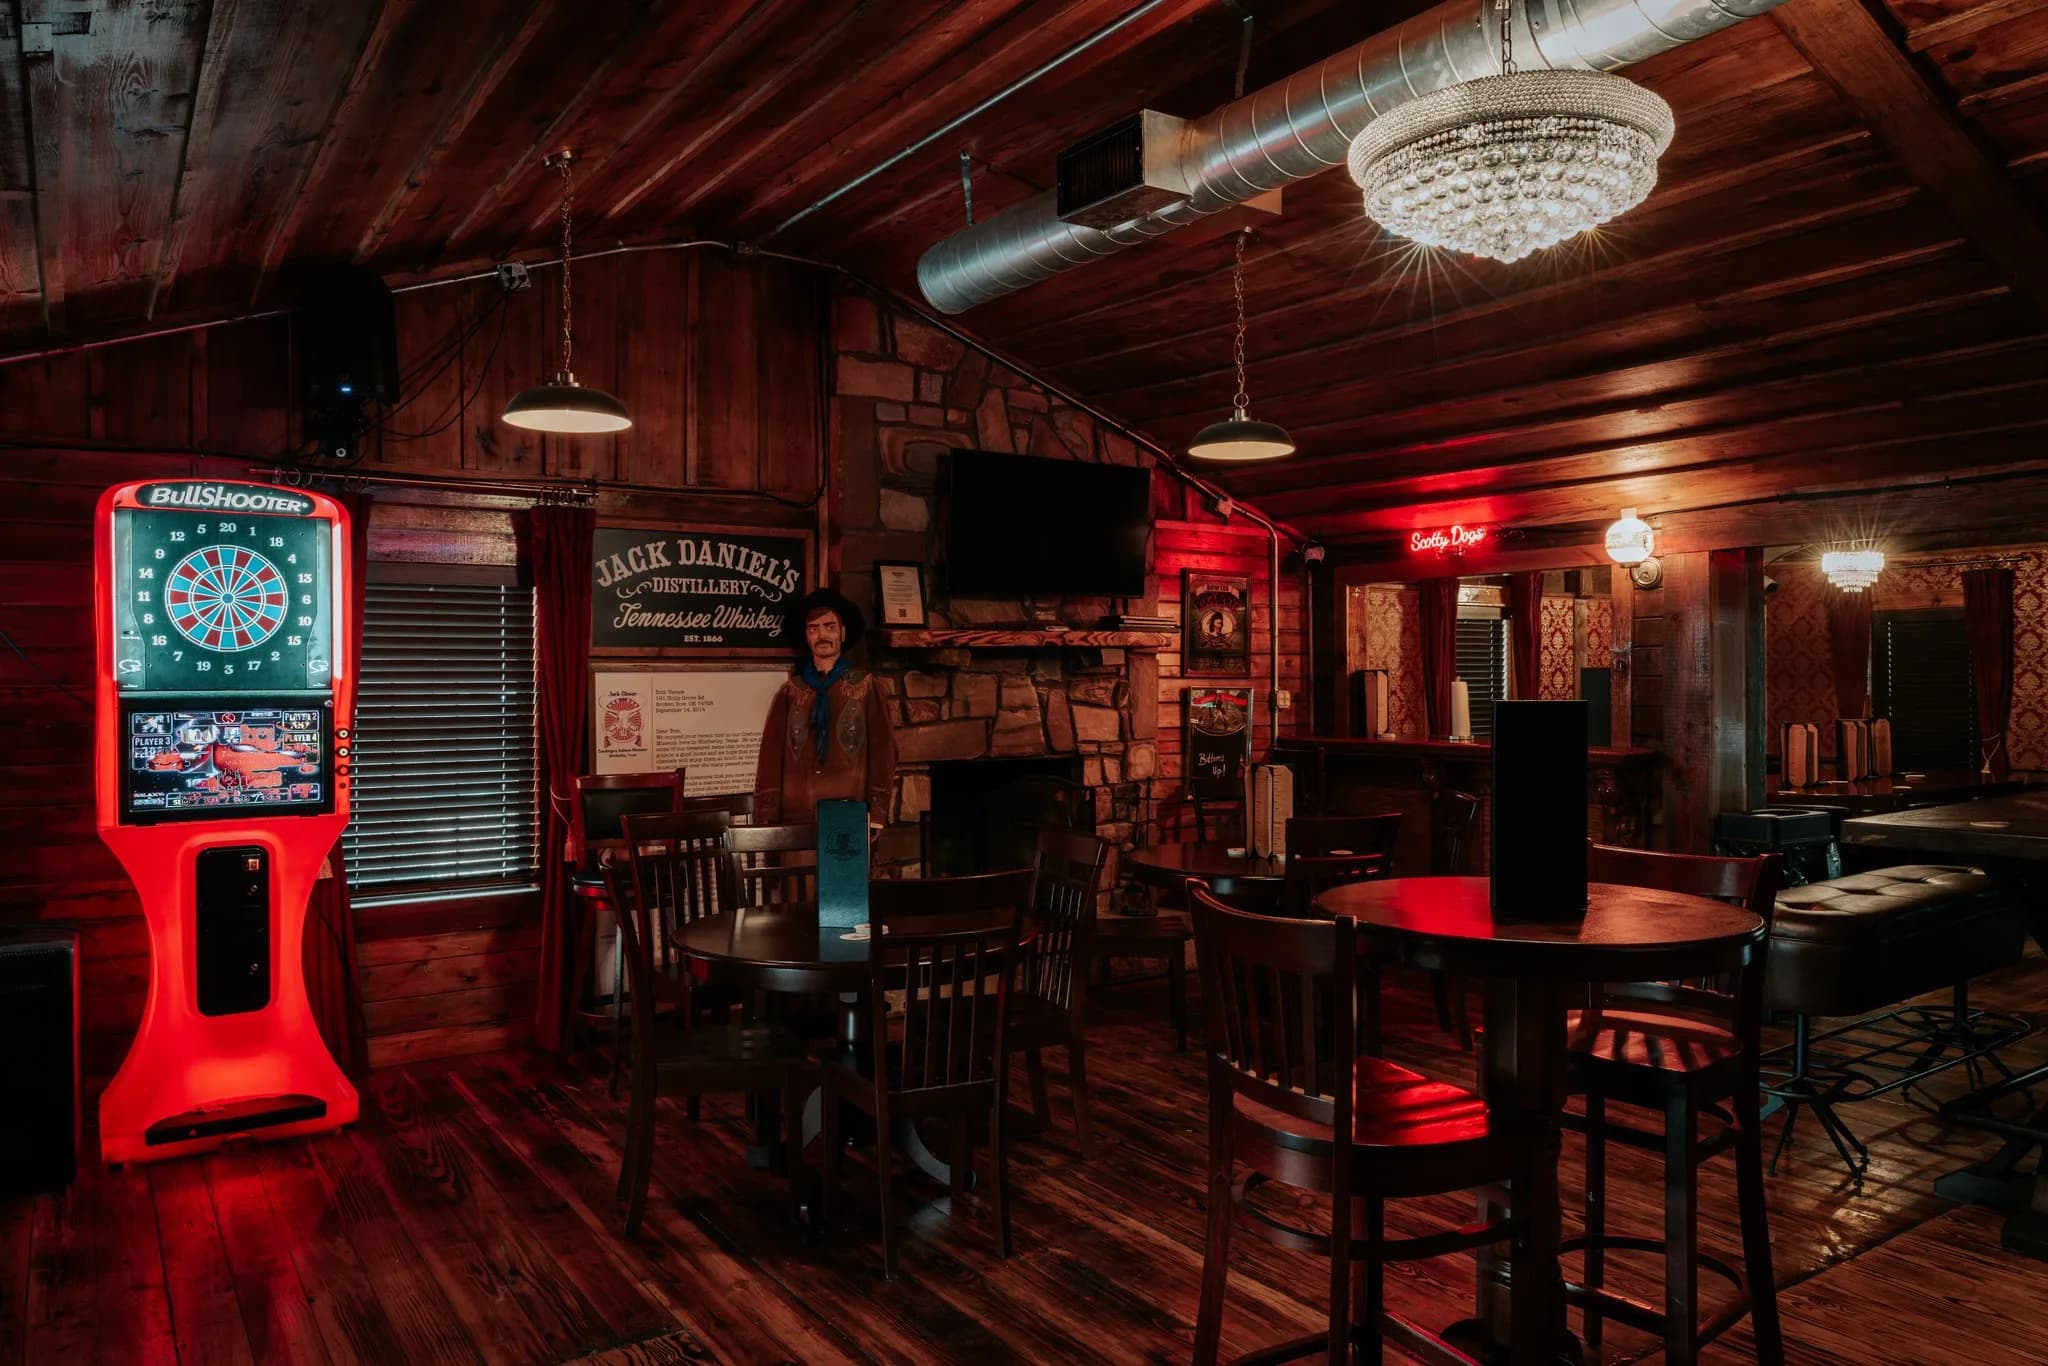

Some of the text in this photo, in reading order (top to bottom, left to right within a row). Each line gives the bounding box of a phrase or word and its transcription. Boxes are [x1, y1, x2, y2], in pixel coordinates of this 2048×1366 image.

[196, 524, 206, 534] 5
[219, 523, 236, 532] 20
[249, 527, 256, 536] 1
[169, 531, 185, 541] 12
[269, 537, 284, 547] 18
[154, 549, 165, 559] 9
[287, 554, 296, 564] 4
[596, 539, 800, 594] JACK DANIEL'S
[137, 568, 153, 579] 14
[297, 573, 312, 583] 13
[652, 577, 751, 595] DISTILLERY
[136, 591, 150, 602] 11
[301, 595, 311, 604] 6
[143, 613, 154, 624] 8
[297, 616, 313, 627] 10
[613, 602, 784, 637] Tennessee Whiskey
[151, 635, 167, 646] 16
[287, 636, 301, 645] 15
[172, 651, 183, 661] 7
[270, 651, 280, 661] 2
[196, 661, 211, 671] 19
[223, 665, 233, 674] 3
[247, 661, 261, 670] 17
[135, 736, 171, 746] PLAYER 3
